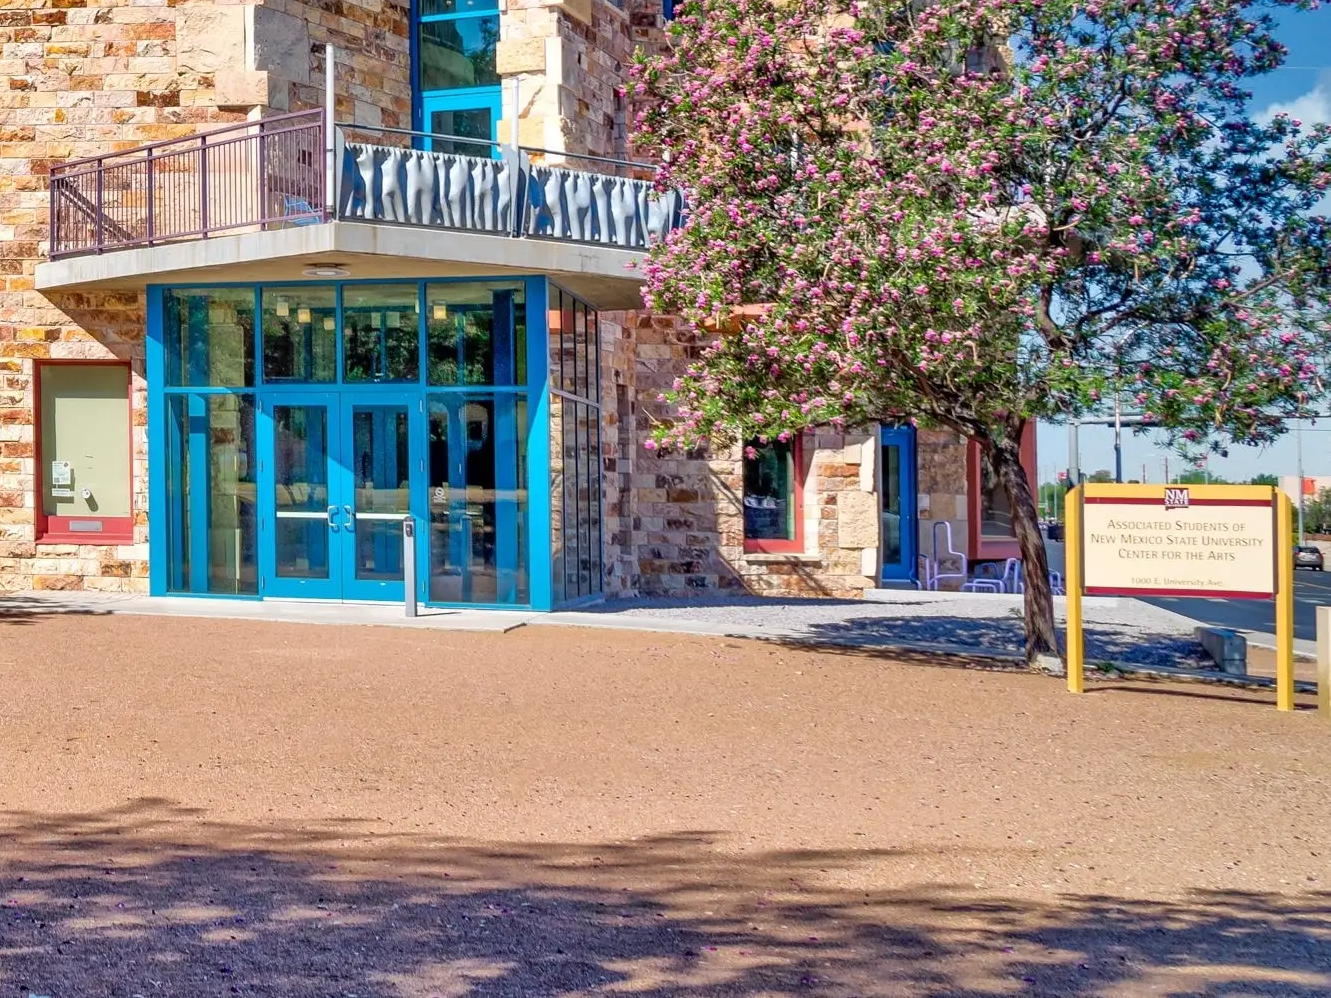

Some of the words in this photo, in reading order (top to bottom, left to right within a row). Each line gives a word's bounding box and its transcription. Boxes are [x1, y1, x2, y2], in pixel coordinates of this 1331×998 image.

[1165, 489, 1188, 499] NM
[1107, 519, 1172, 530] ASSOCIATED
[1175, 520, 1229, 531] STUDENTS
[1232, 523, 1246, 532] OF
[1091, 533, 1116, 543] NEW
[1120, 534, 1163, 544] MEXICO
[1166, 535, 1198, 545] STATE
[1201, 536, 1263, 546] UNIVERSITY
[1118, 548, 1158, 559] CENTER
[1161, 550, 1182, 559] FOR
[1185, 551, 1204, 560] THE
[1208, 551, 1236, 561] ARTS
[1163, 578, 1204, 586] University
